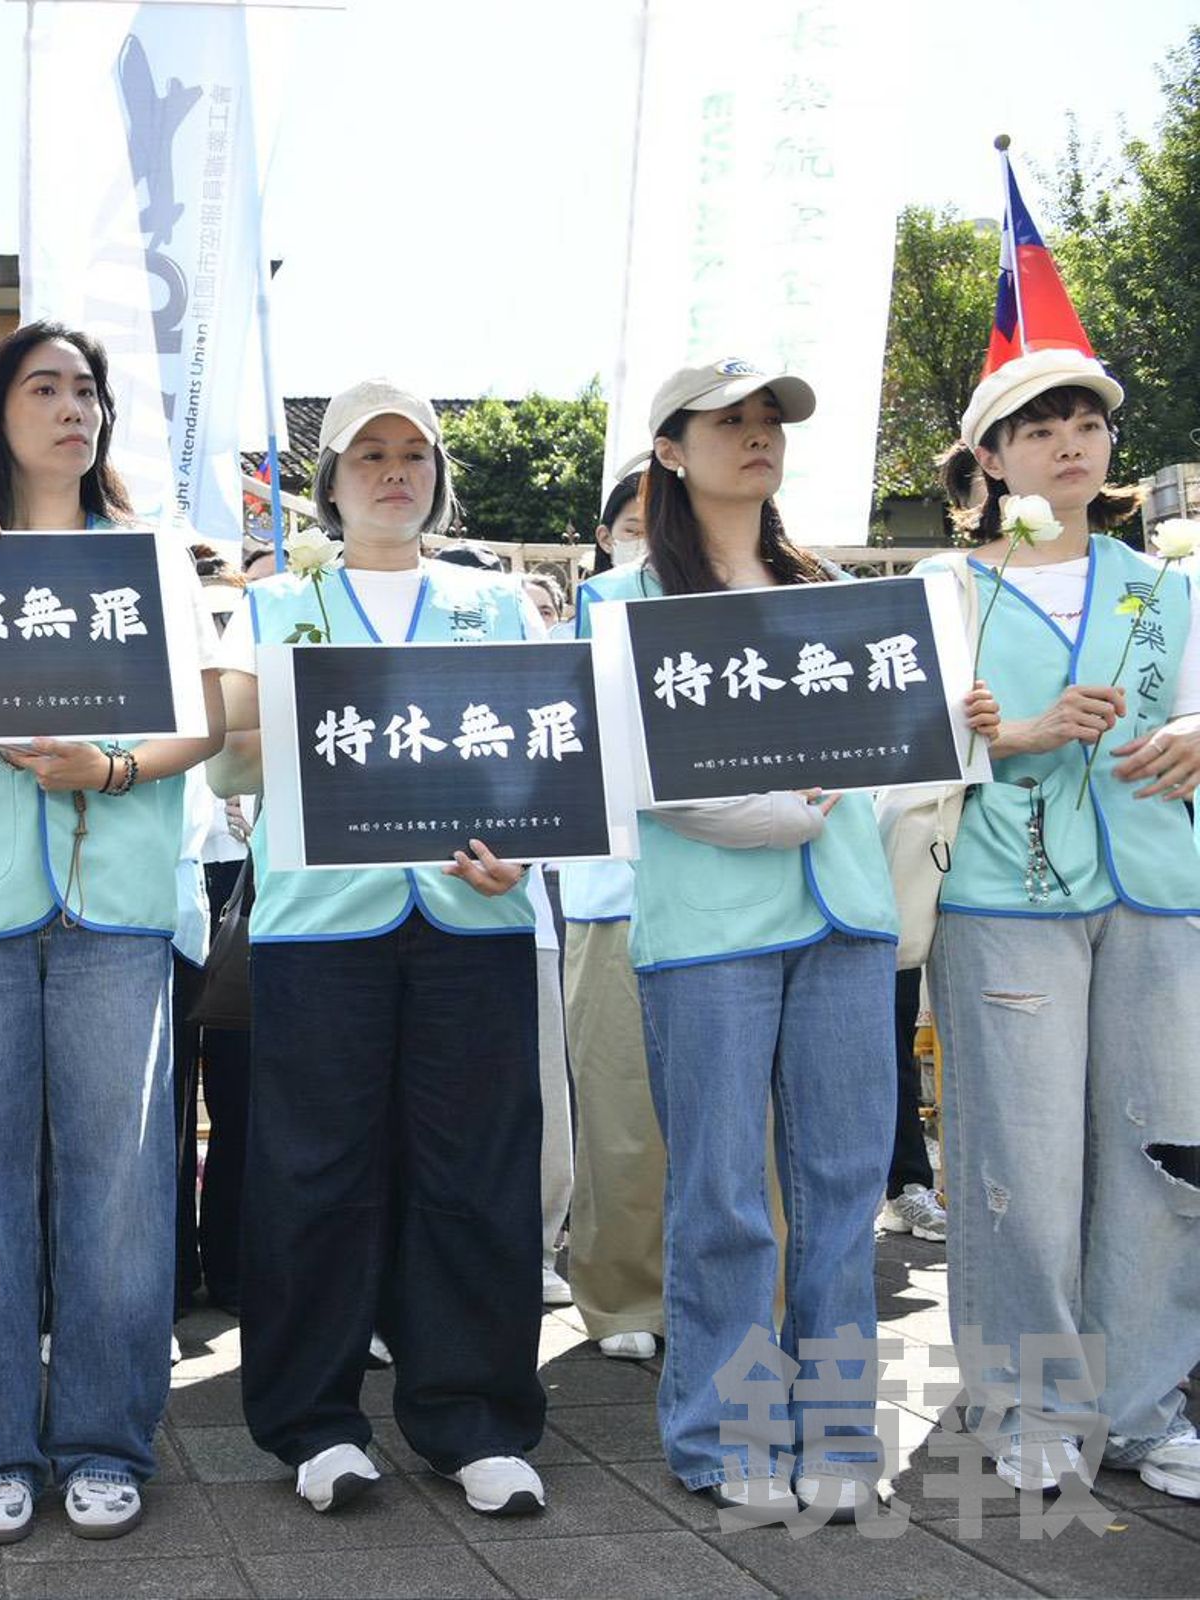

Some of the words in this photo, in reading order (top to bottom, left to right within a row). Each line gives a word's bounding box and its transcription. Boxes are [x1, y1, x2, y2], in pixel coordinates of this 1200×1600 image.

[189, 321, 209, 375] Union
[178, 378, 204, 476] Attendants
[653, 633, 928, 710] 特休無罪
[314, 700, 584, 766] 特休無罪
